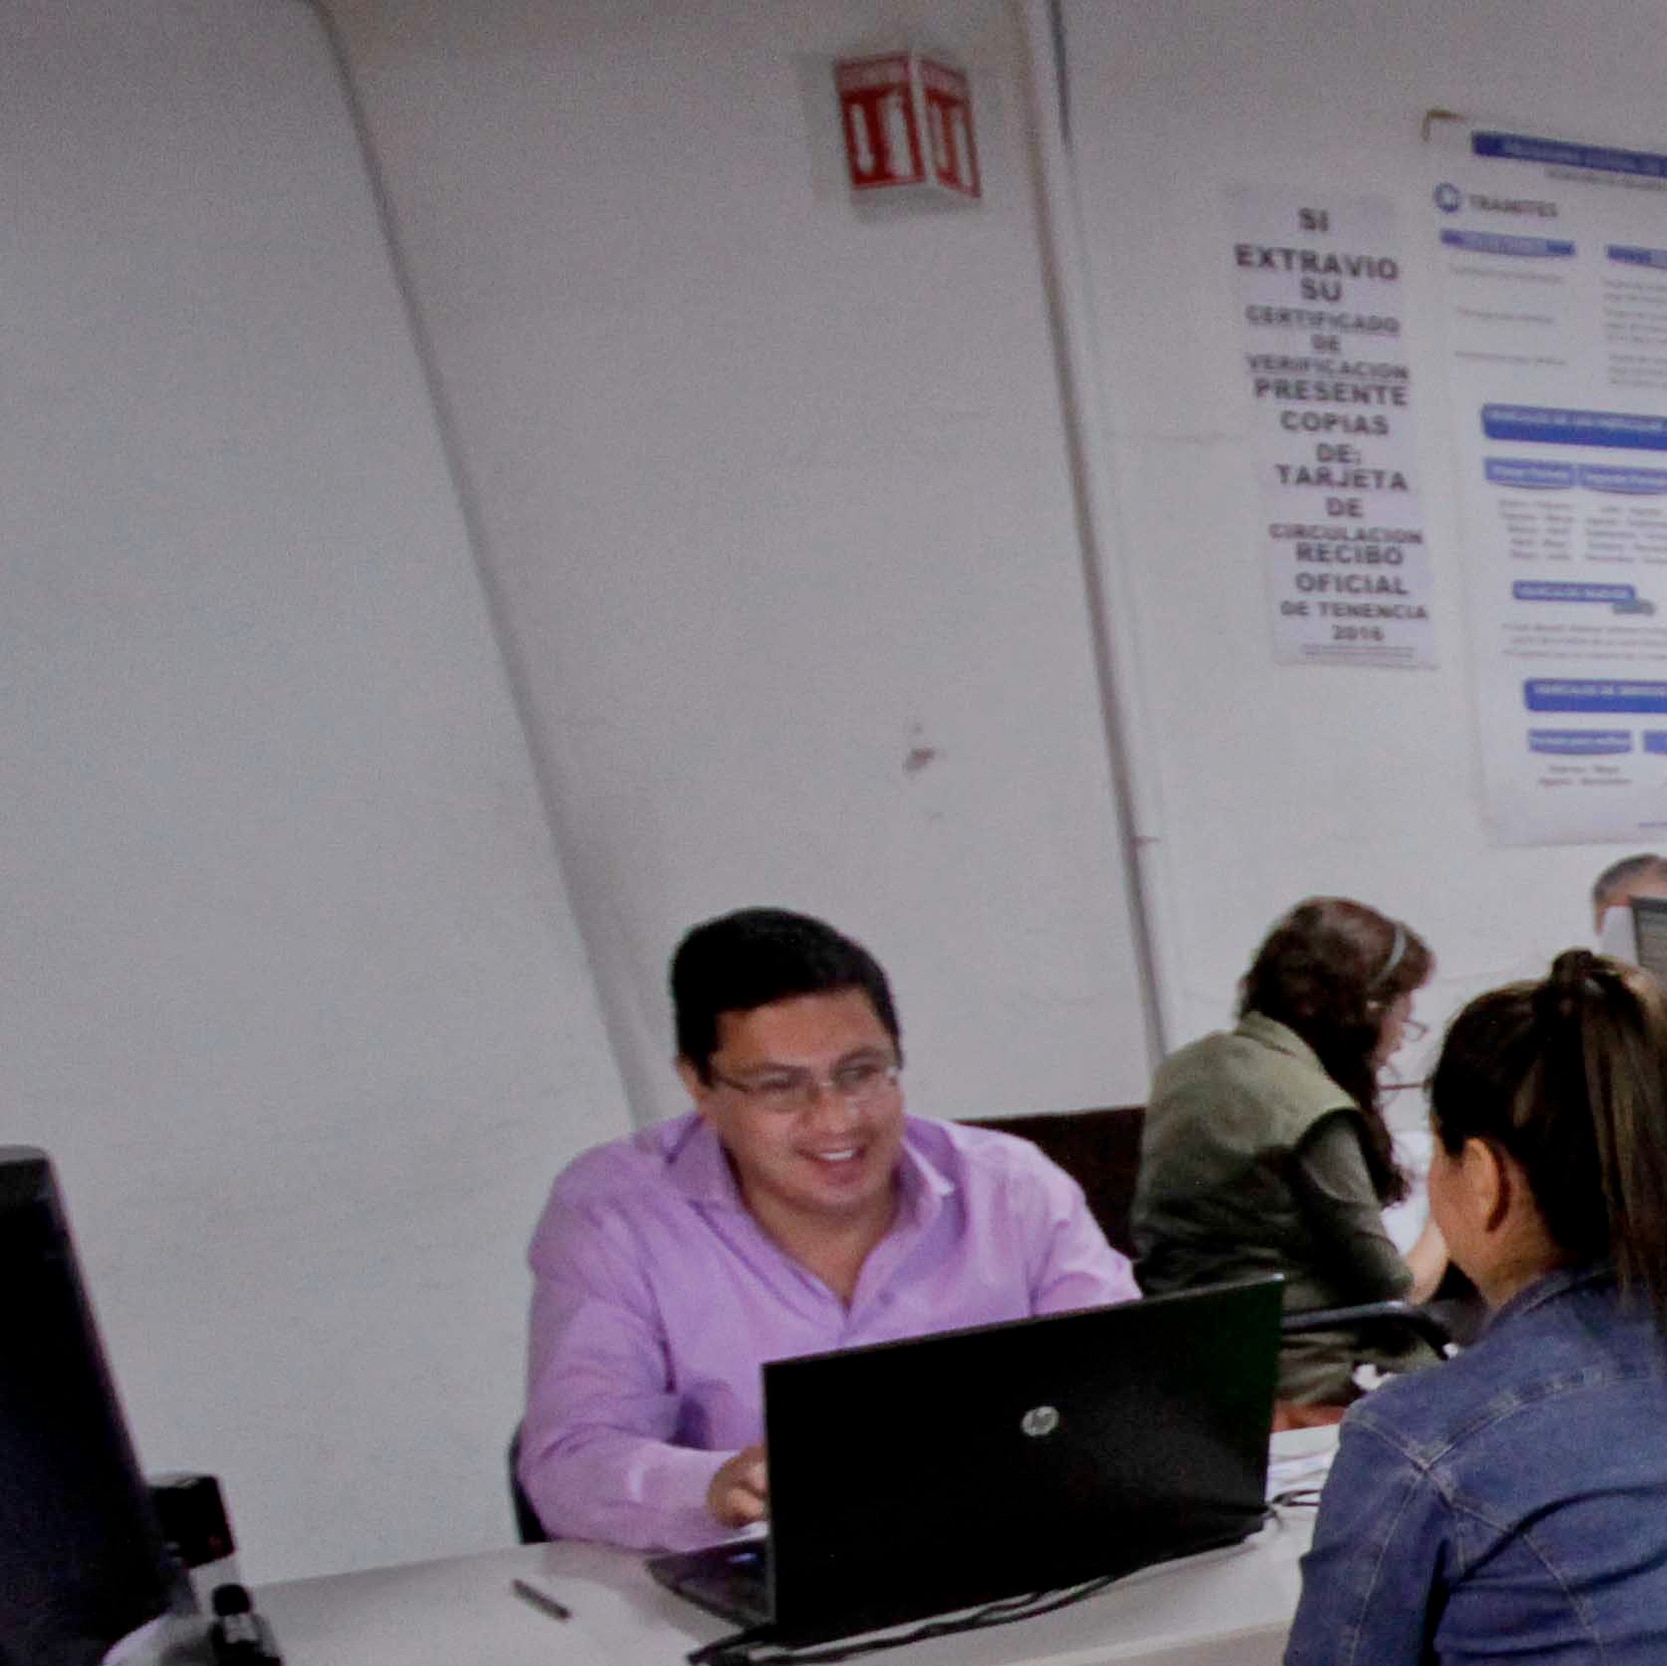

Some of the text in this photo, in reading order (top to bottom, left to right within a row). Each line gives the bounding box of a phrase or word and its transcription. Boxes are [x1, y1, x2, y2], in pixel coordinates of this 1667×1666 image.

[1298, 207, 1329, 232] SI
[1234, 244, 1398, 280] EXTRAVIO
[1301, 278, 1341, 302] SU
[1245, 304, 1401, 334] CERTIFICADO
[1311, 334, 1341, 353] DE
[1247, 355, 1410, 381] VERIFICACION
[1254, 379, 1408, 407] PRESENTE
[1280, 410, 1389, 436] COPIAS
[1275, 465, 1408, 491] TARJETA
[1326, 498, 1362, 518] DE
[1269, 523, 1423, 545] CIRCULACION
[1296, 543, 1404, 566] RECIBO
[1296, 573, 1409, 595] OFICIAL
[1281, 601, 1428, 620] DE TENENCIA
